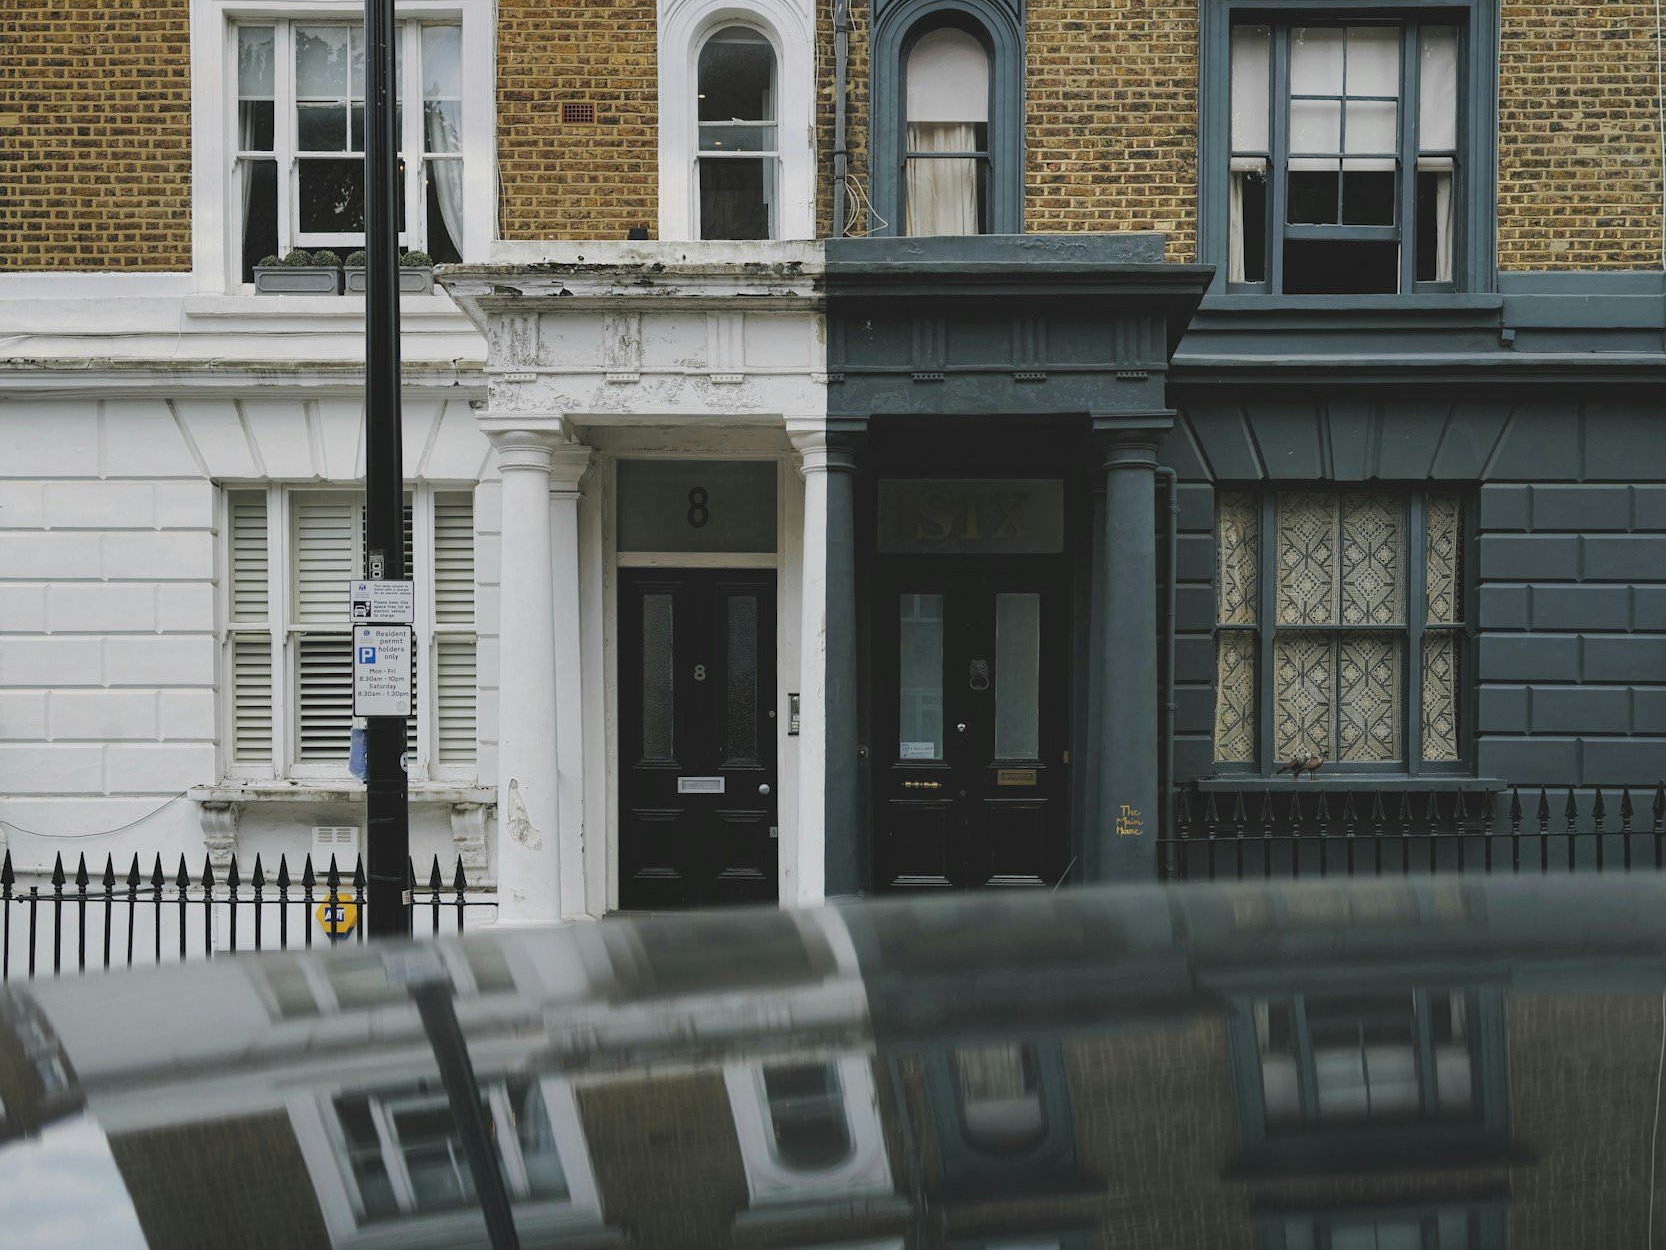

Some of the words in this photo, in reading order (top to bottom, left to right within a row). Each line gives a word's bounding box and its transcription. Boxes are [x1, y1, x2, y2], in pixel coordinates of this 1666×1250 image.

[688, 487, 708, 528] 8
[916, 491, 1032, 542] SIX
[361, 648, 373, 663] P
[694, 664, 705, 680] 8
[1120, 805, 1141, 816] The
[325, 908, 344, 921] AT
